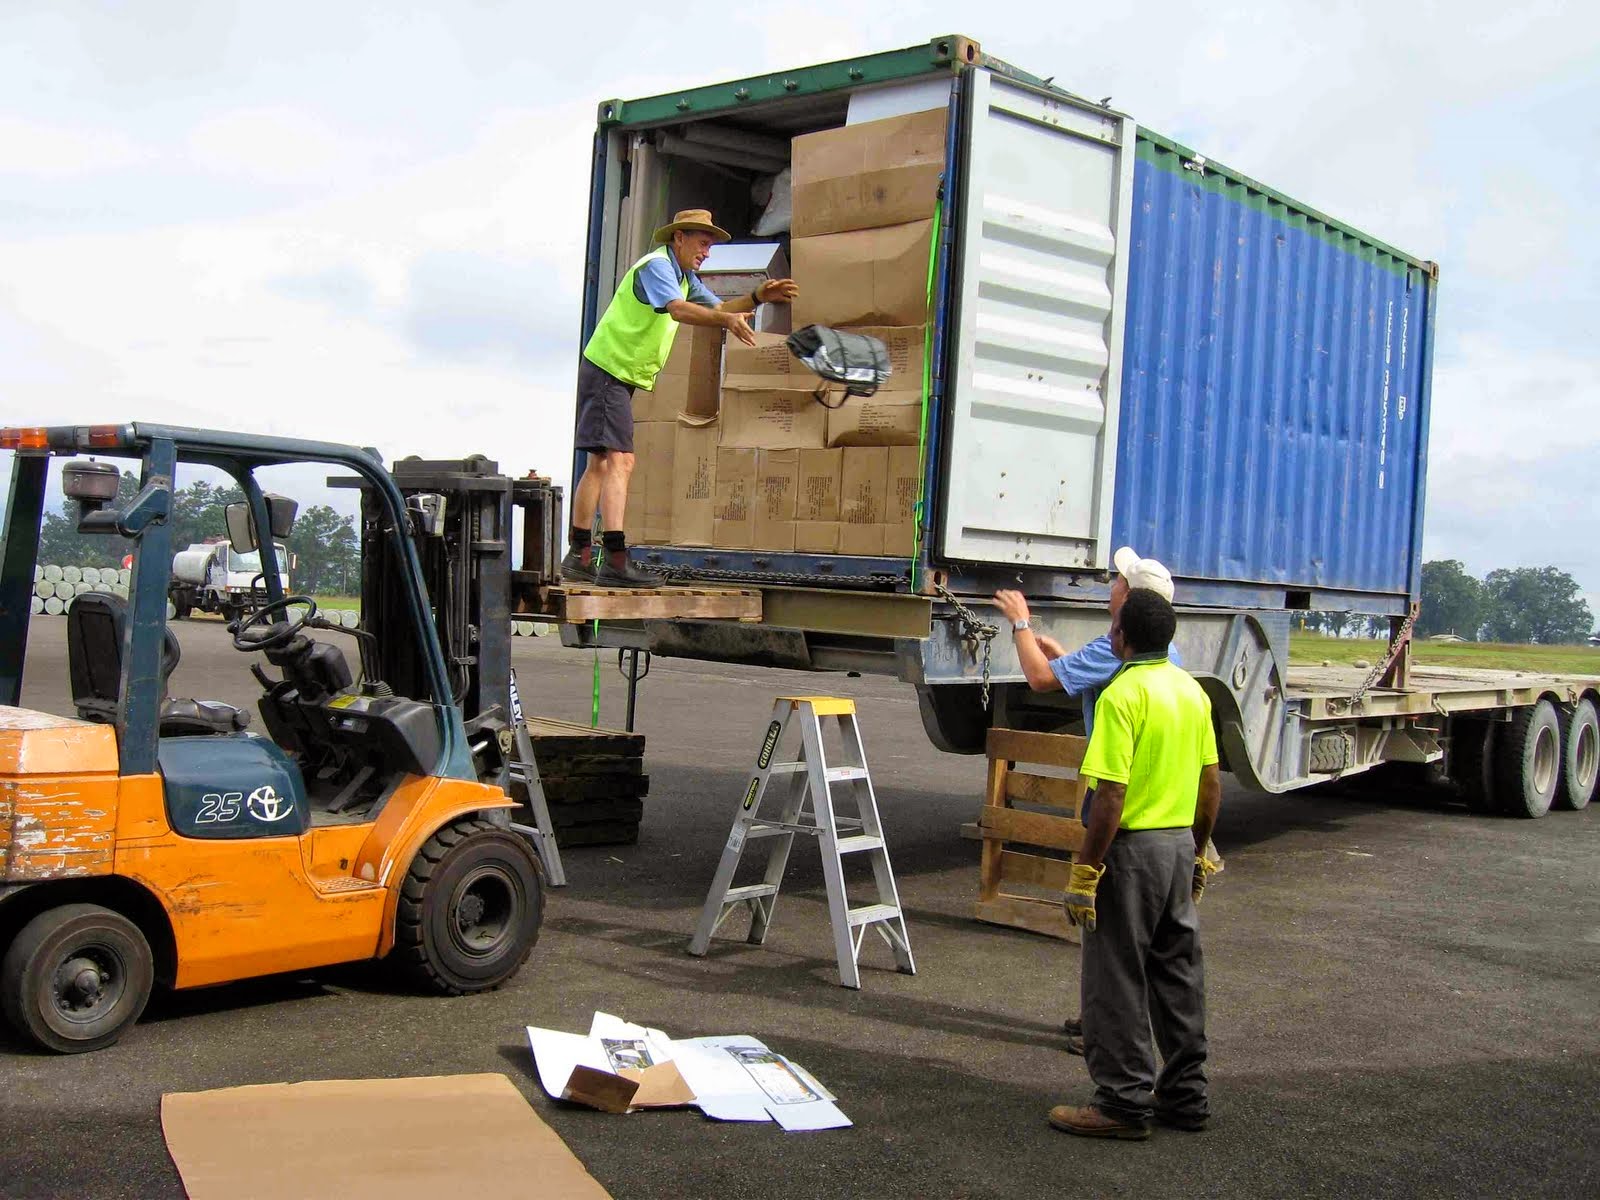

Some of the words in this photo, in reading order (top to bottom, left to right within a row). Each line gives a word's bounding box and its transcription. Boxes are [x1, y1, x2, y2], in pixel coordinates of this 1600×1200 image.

[1380, 370, 1389, 465] 305340
[760, 725, 780, 768] GORILL
[195, 792, 243, 824] 25
